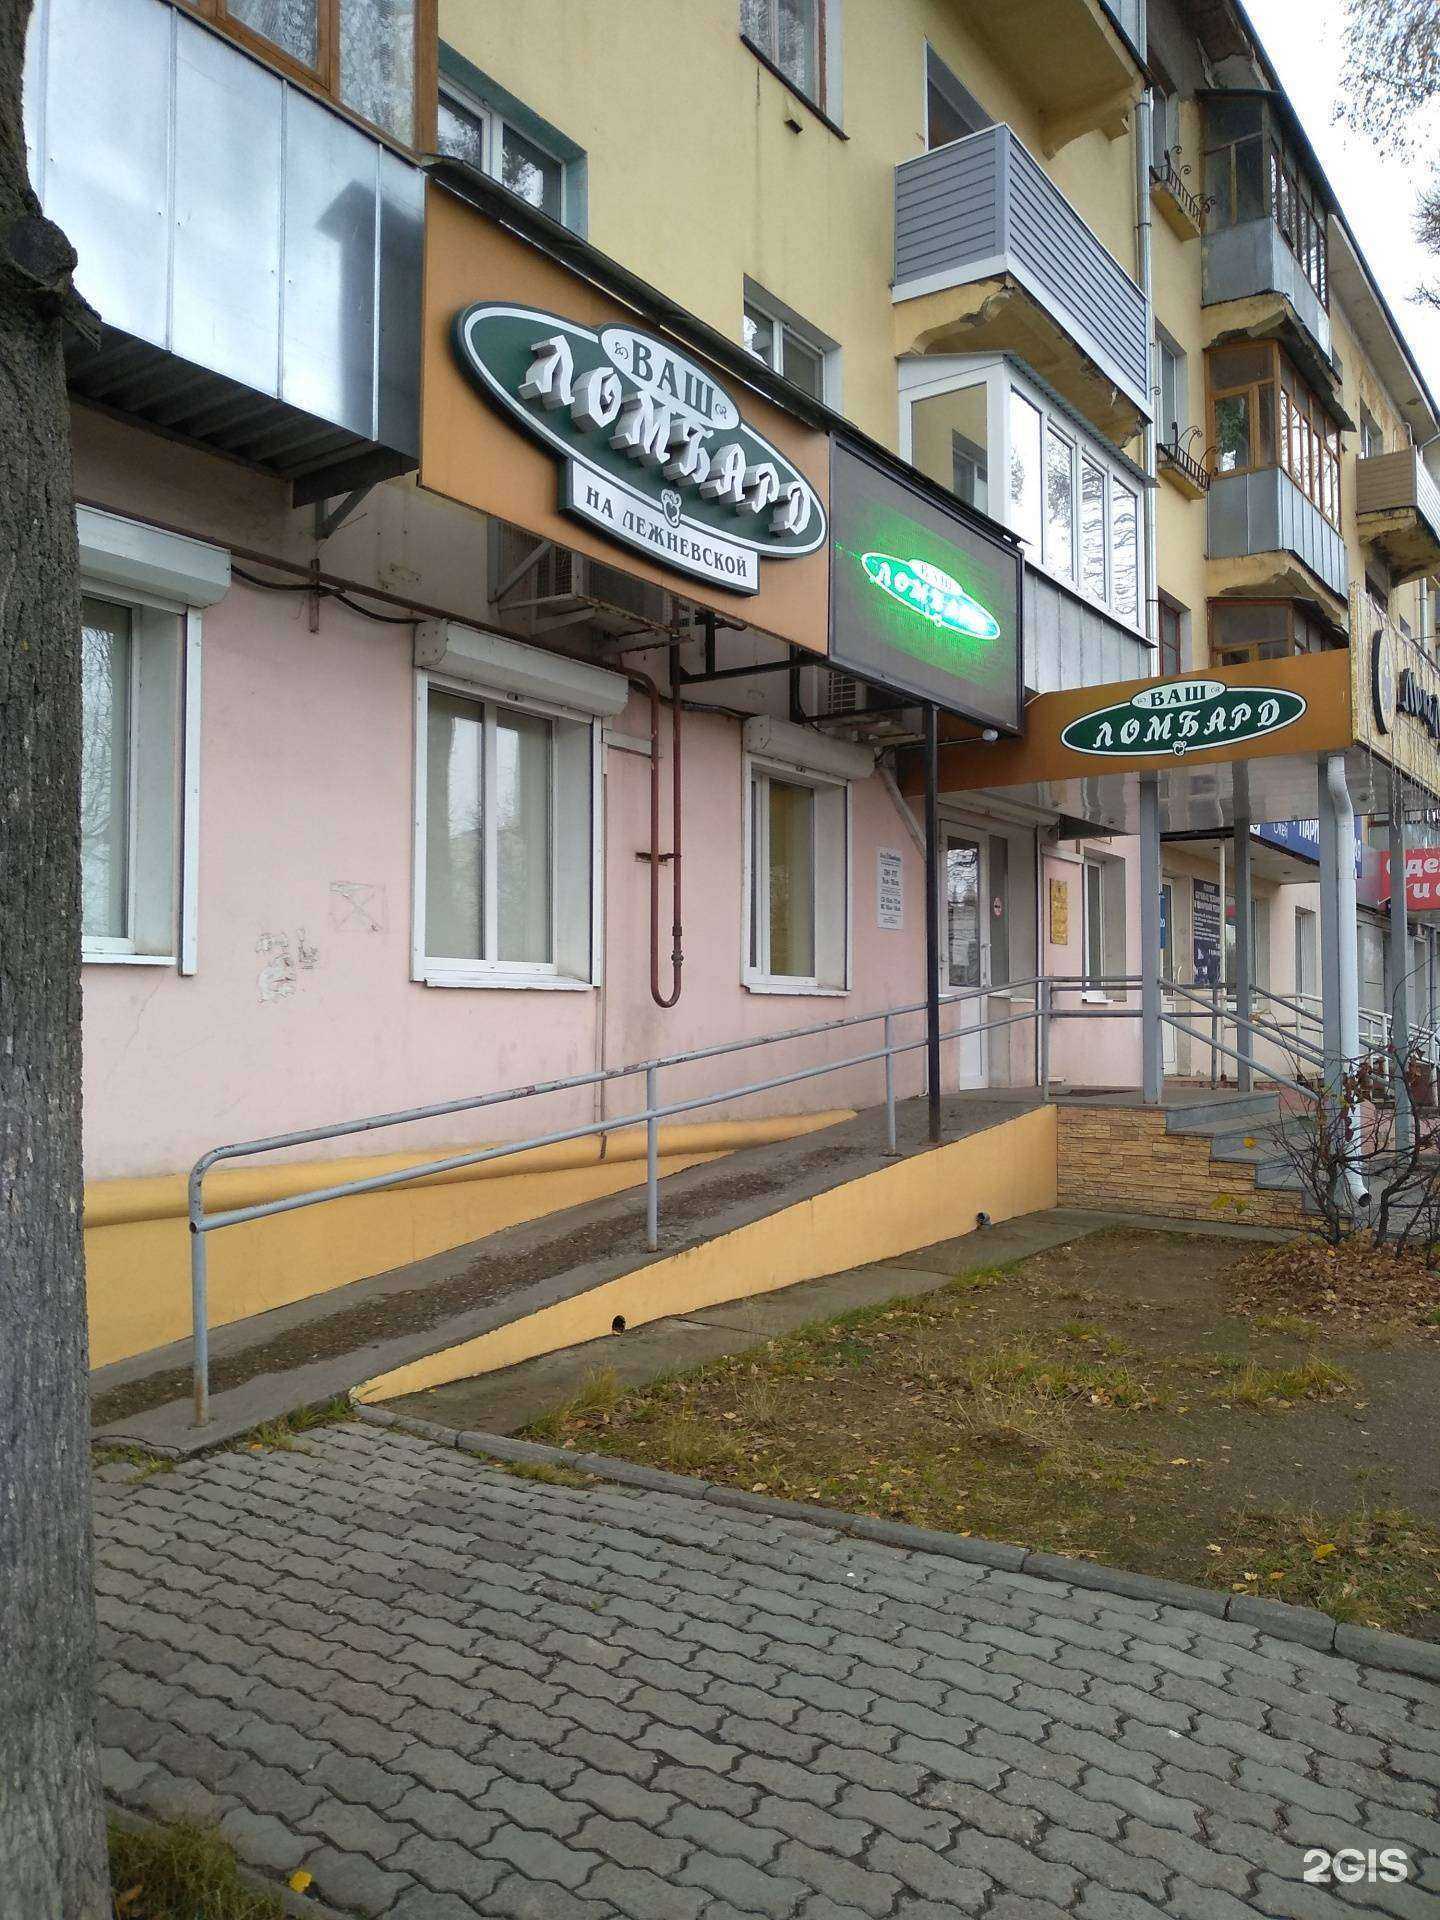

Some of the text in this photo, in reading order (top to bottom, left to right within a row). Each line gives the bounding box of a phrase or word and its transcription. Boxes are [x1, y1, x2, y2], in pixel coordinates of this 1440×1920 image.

[630, 337, 716, 422] ВАШ
[518, 333, 812, 538] ЛОМБАРД
[585, 484, 748, 578] НА ЛЕЖНЕВСКОЙ
[871, 561, 992, 636] ЛОМБ
[1092, 698, 1281, 749] ЛОМБАРД
[1150, 685, 1207, 708] ВАШ
